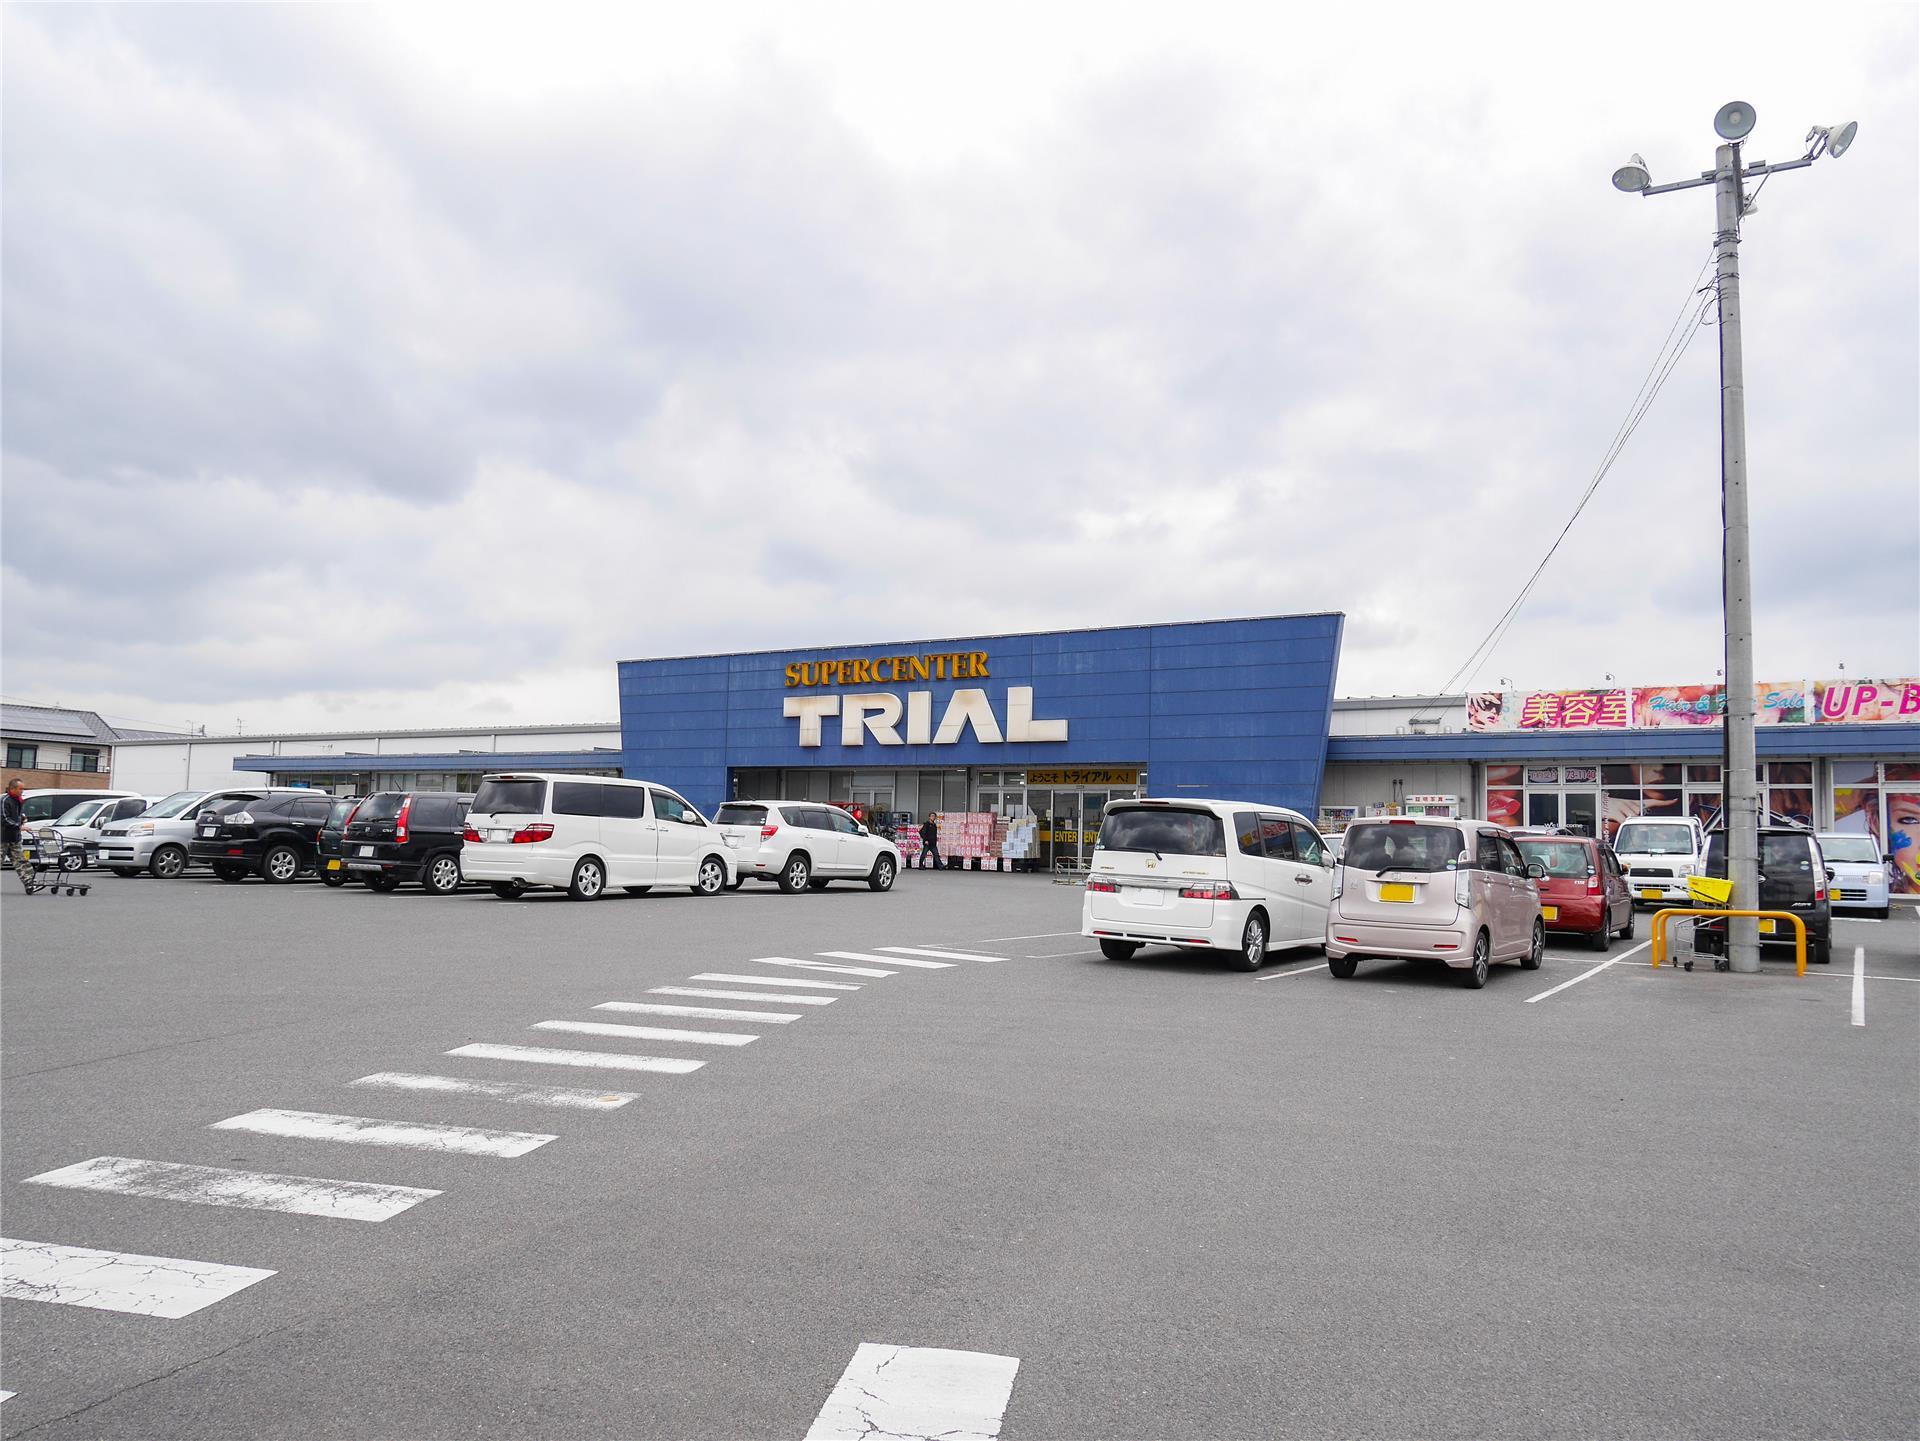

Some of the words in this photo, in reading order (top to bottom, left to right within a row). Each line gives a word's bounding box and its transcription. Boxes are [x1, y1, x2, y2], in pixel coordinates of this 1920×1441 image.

[785, 651, 990, 687] SUPERCENTER
[1521, 689, 1636, 727] 美容室
[1649, 695, 1691, 711] Hair
[783, 686, 1069, 747] TRIAL
[1030, 773, 1059, 783] ようこそ
[1063, 771, 1112, 782] トライアル
[1054, 831, 1077, 842] ENTER
